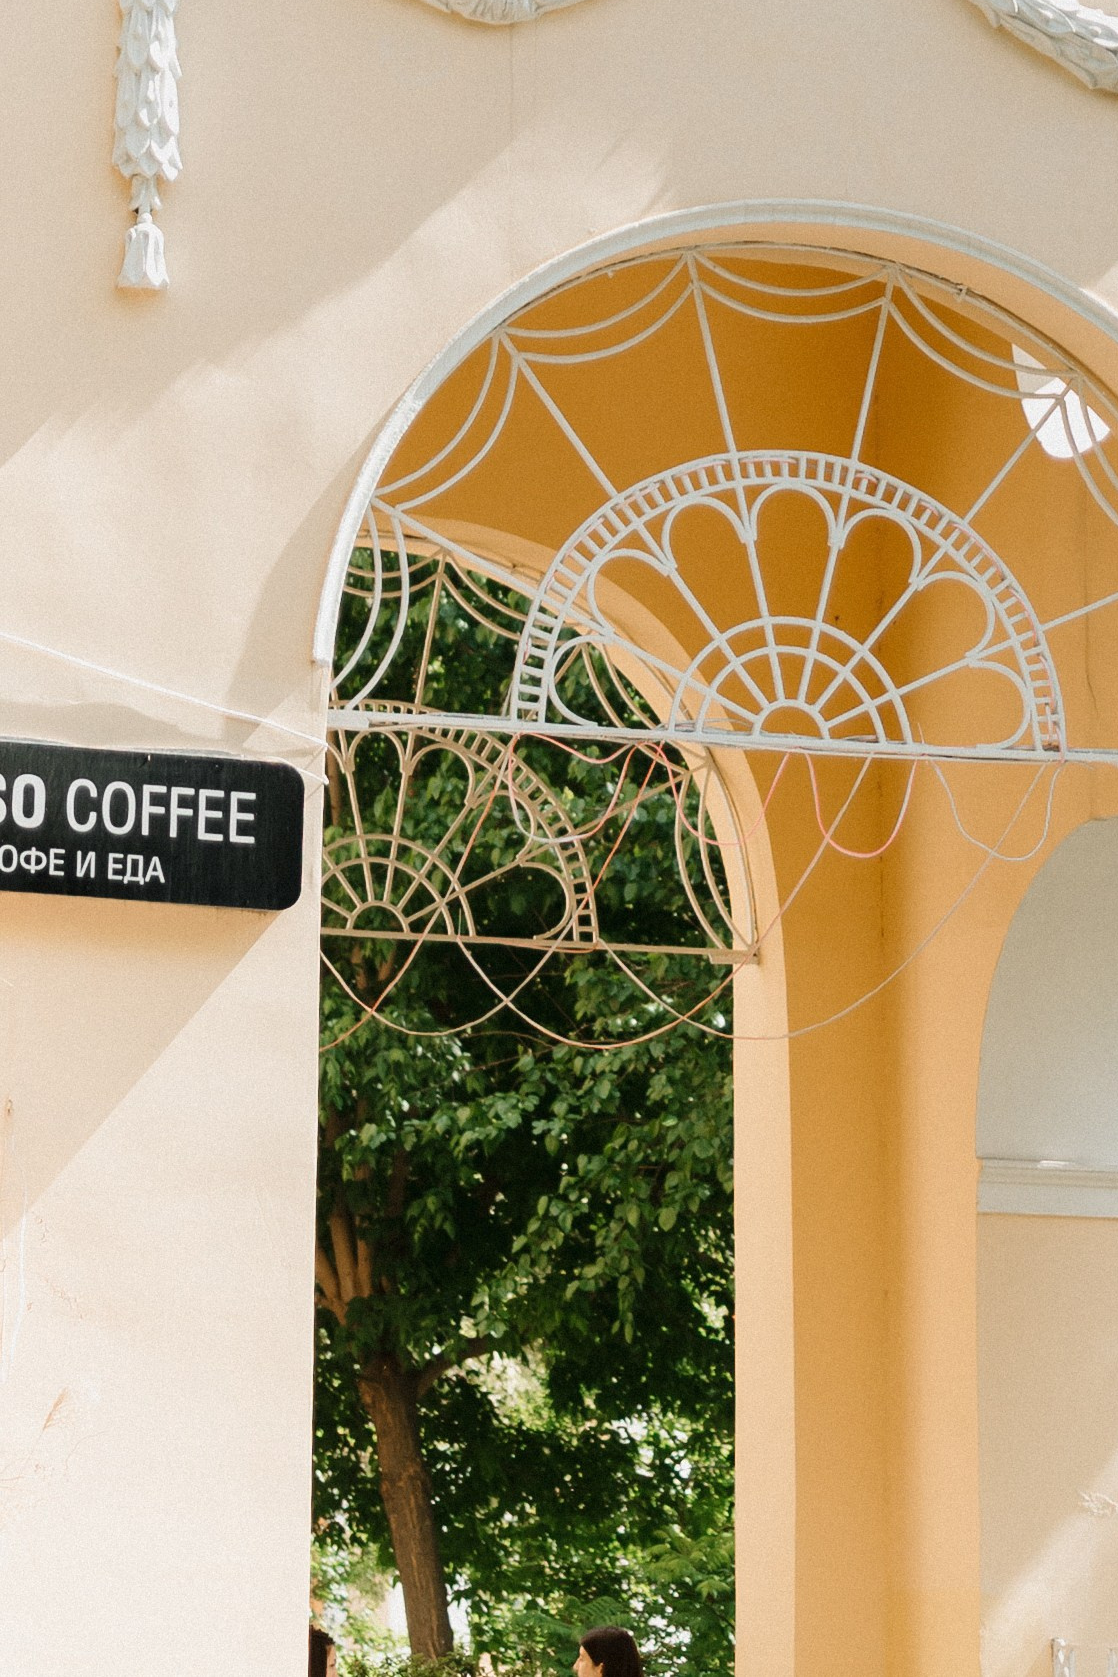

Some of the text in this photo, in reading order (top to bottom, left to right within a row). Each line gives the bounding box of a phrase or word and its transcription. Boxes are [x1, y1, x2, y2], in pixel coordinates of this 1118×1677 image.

[0, 773, 257, 845] O COFFEE
[76, 850, 96, 879] И
[107, 852, 166, 886] ЕДА
